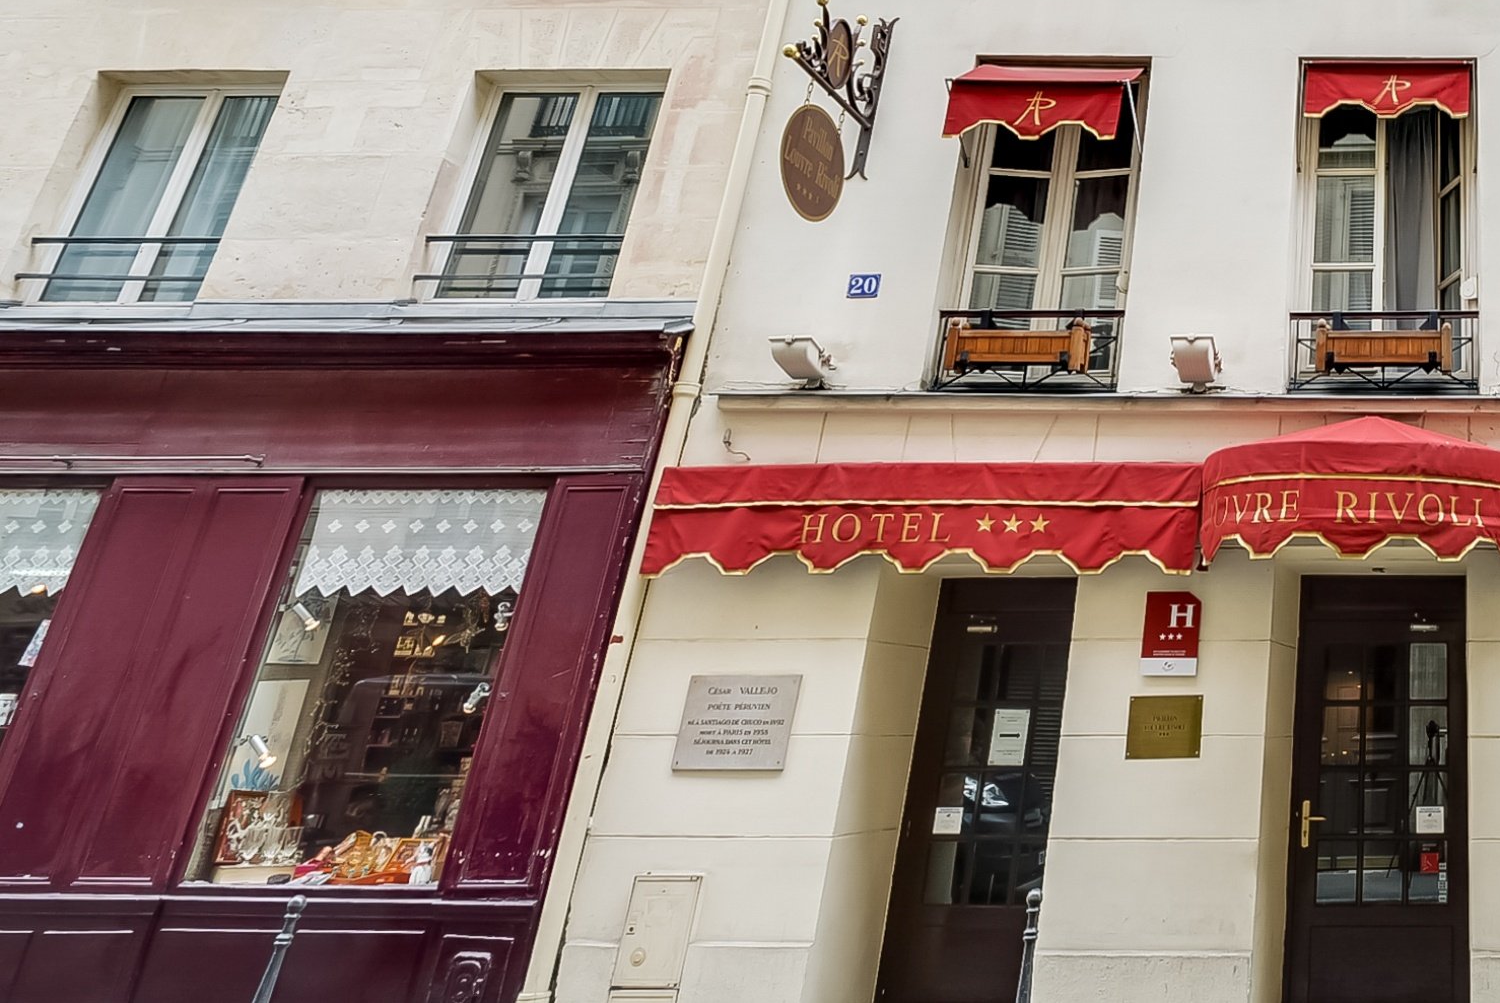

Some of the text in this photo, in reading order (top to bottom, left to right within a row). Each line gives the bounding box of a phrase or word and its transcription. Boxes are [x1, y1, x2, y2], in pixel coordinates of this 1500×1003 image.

[803, 116, 834, 162] Pavillon
[784, 135, 841, 199] Louvre Rivoli
[850, 277, 877, 295] 20
[1333, 490, 1485, 528] RIVOLI
[800, 512, 951, 544] HOTEL
[1167, 603, 1197, 629] H
[740, 686, 778, 695] VALLEJO
